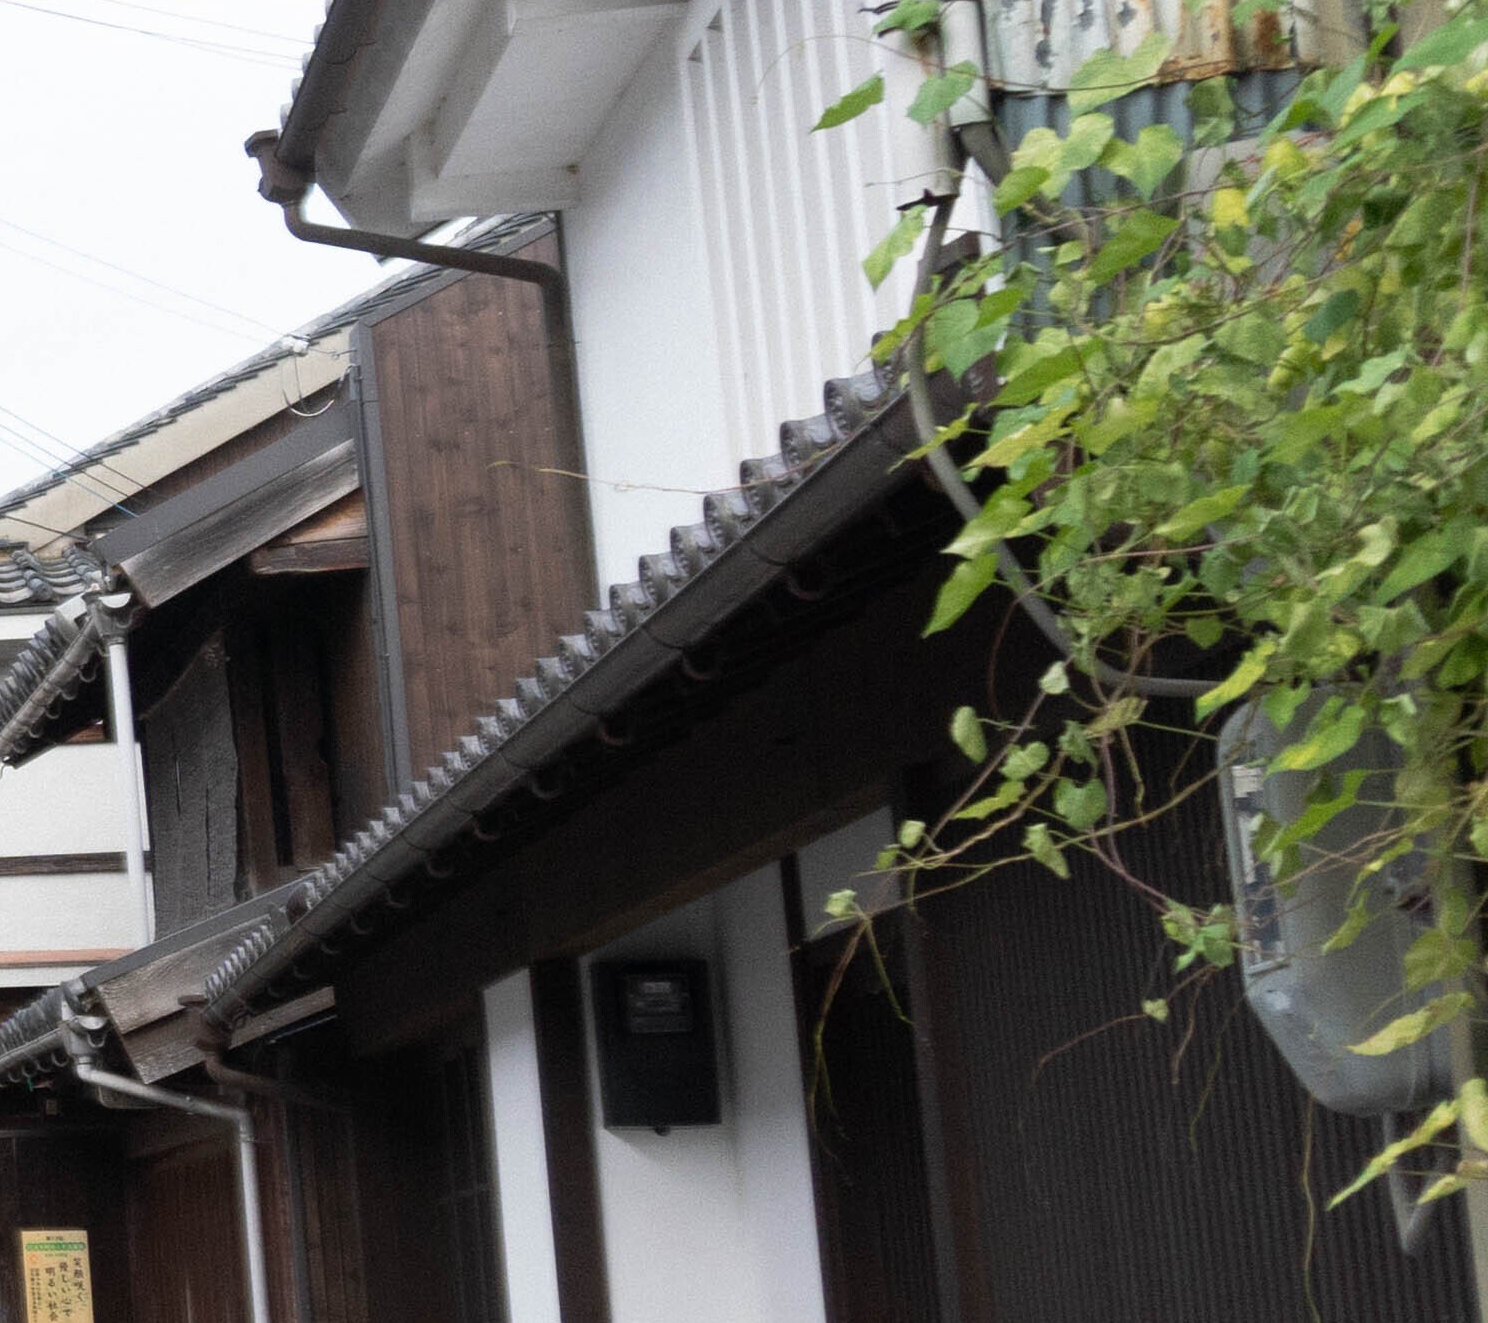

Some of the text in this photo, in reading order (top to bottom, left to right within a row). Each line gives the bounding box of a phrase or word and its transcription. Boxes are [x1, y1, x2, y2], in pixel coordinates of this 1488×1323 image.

[44, 1266, 59, 1323] 明るい社会
